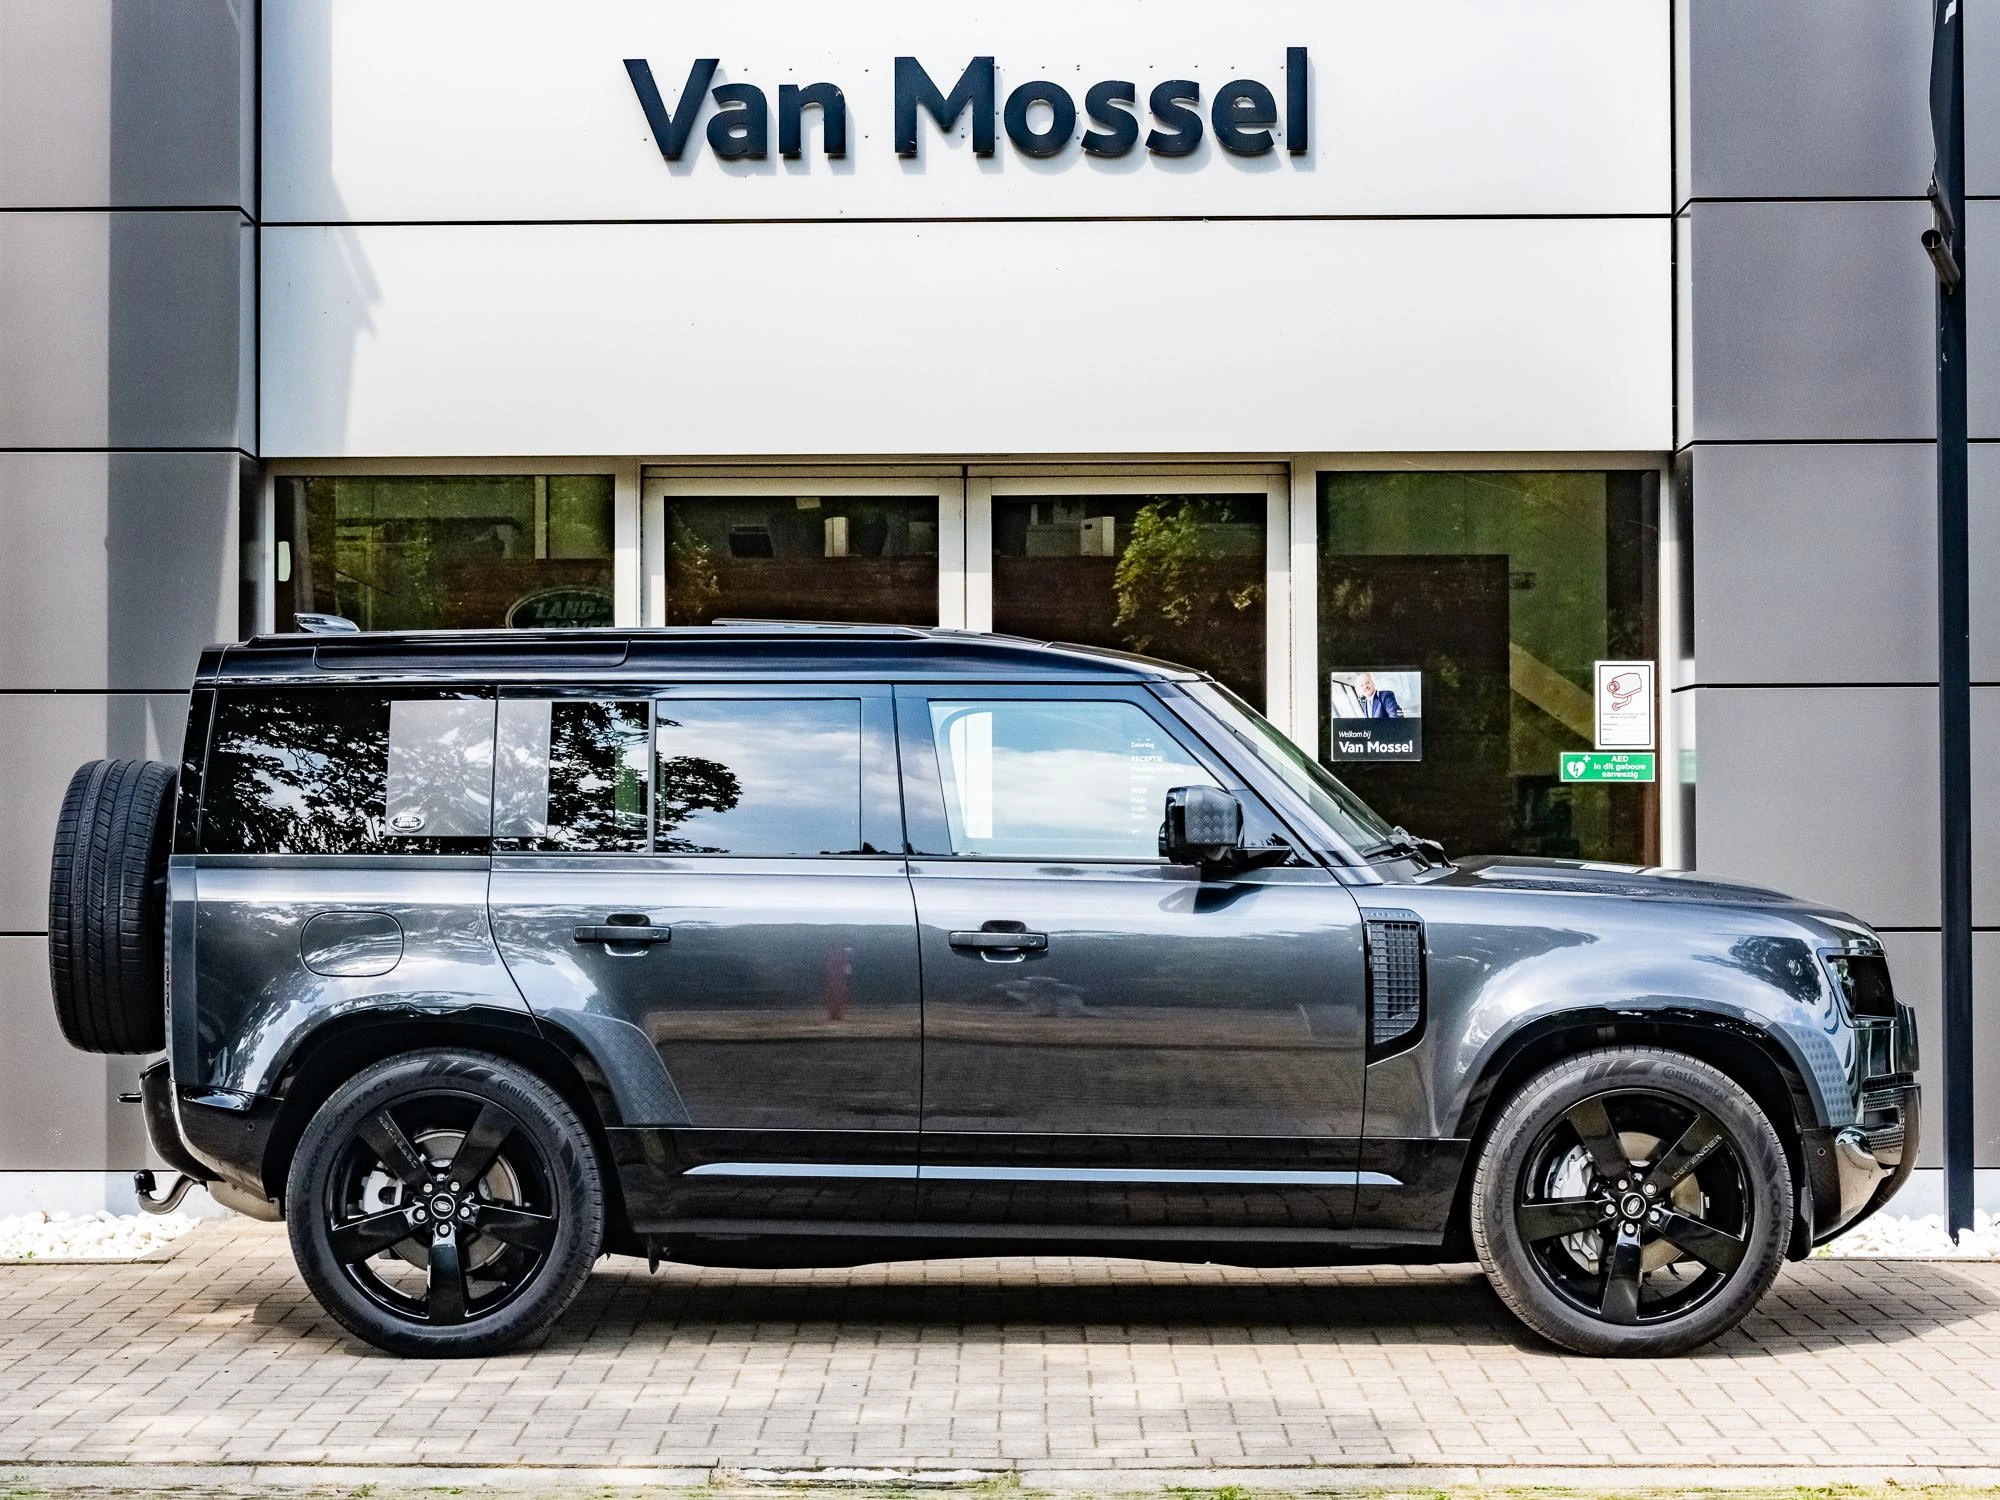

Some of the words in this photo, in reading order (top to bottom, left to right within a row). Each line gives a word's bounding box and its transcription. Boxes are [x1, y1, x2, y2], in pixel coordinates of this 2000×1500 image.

[622, 57, 846, 160] Van
[894, 45, 1309, 160] Mossel
[1338, 730, 1363, 738] Welkom
[1363, 730, 1372, 740] bij
[1338, 740, 1364, 753] Van
[1367, 739, 1413, 753] Mossel
[1611, 755, 1629, 763] AED
[1603, 762, 1615, 770] dit
[1615, 762, 1647, 772] gebouw
[1601, 771, 1639, 780] aanwezig
[1662, 1066, 1729, 1101] Continental
[496, 1079, 557, 1128] Continental
[1671, 1134, 1722, 1180] DEFENDER
